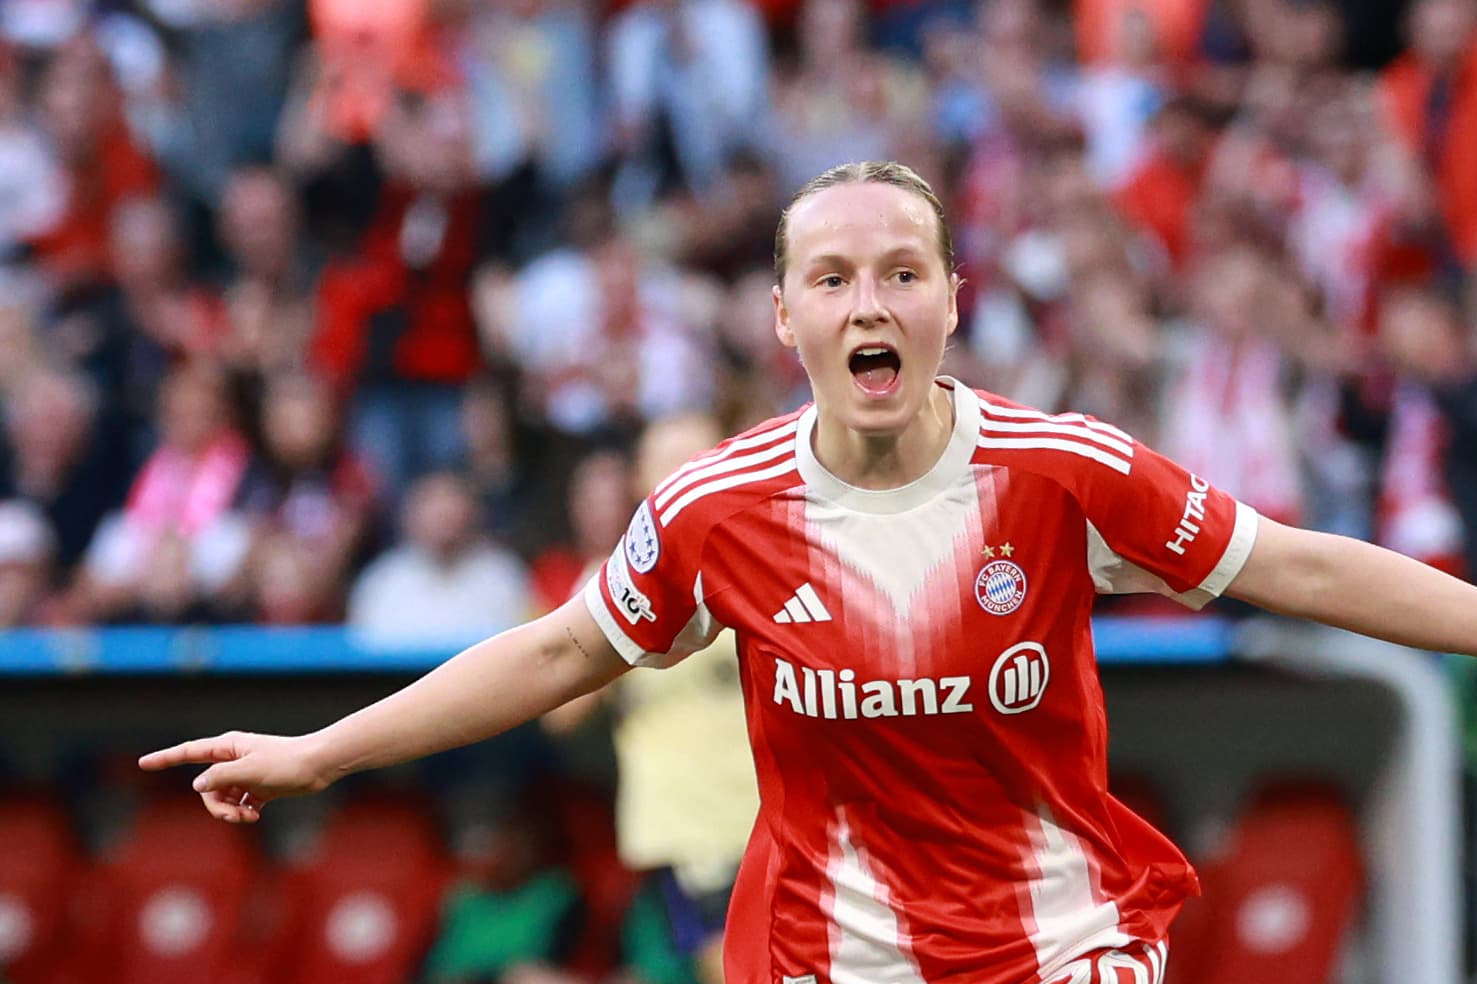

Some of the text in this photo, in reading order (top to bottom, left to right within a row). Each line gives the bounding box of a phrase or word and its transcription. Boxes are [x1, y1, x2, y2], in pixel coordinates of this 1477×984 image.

[979, 564, 1022, 587] FC BAYERN
[773, 658, 973, 720] Allianz
